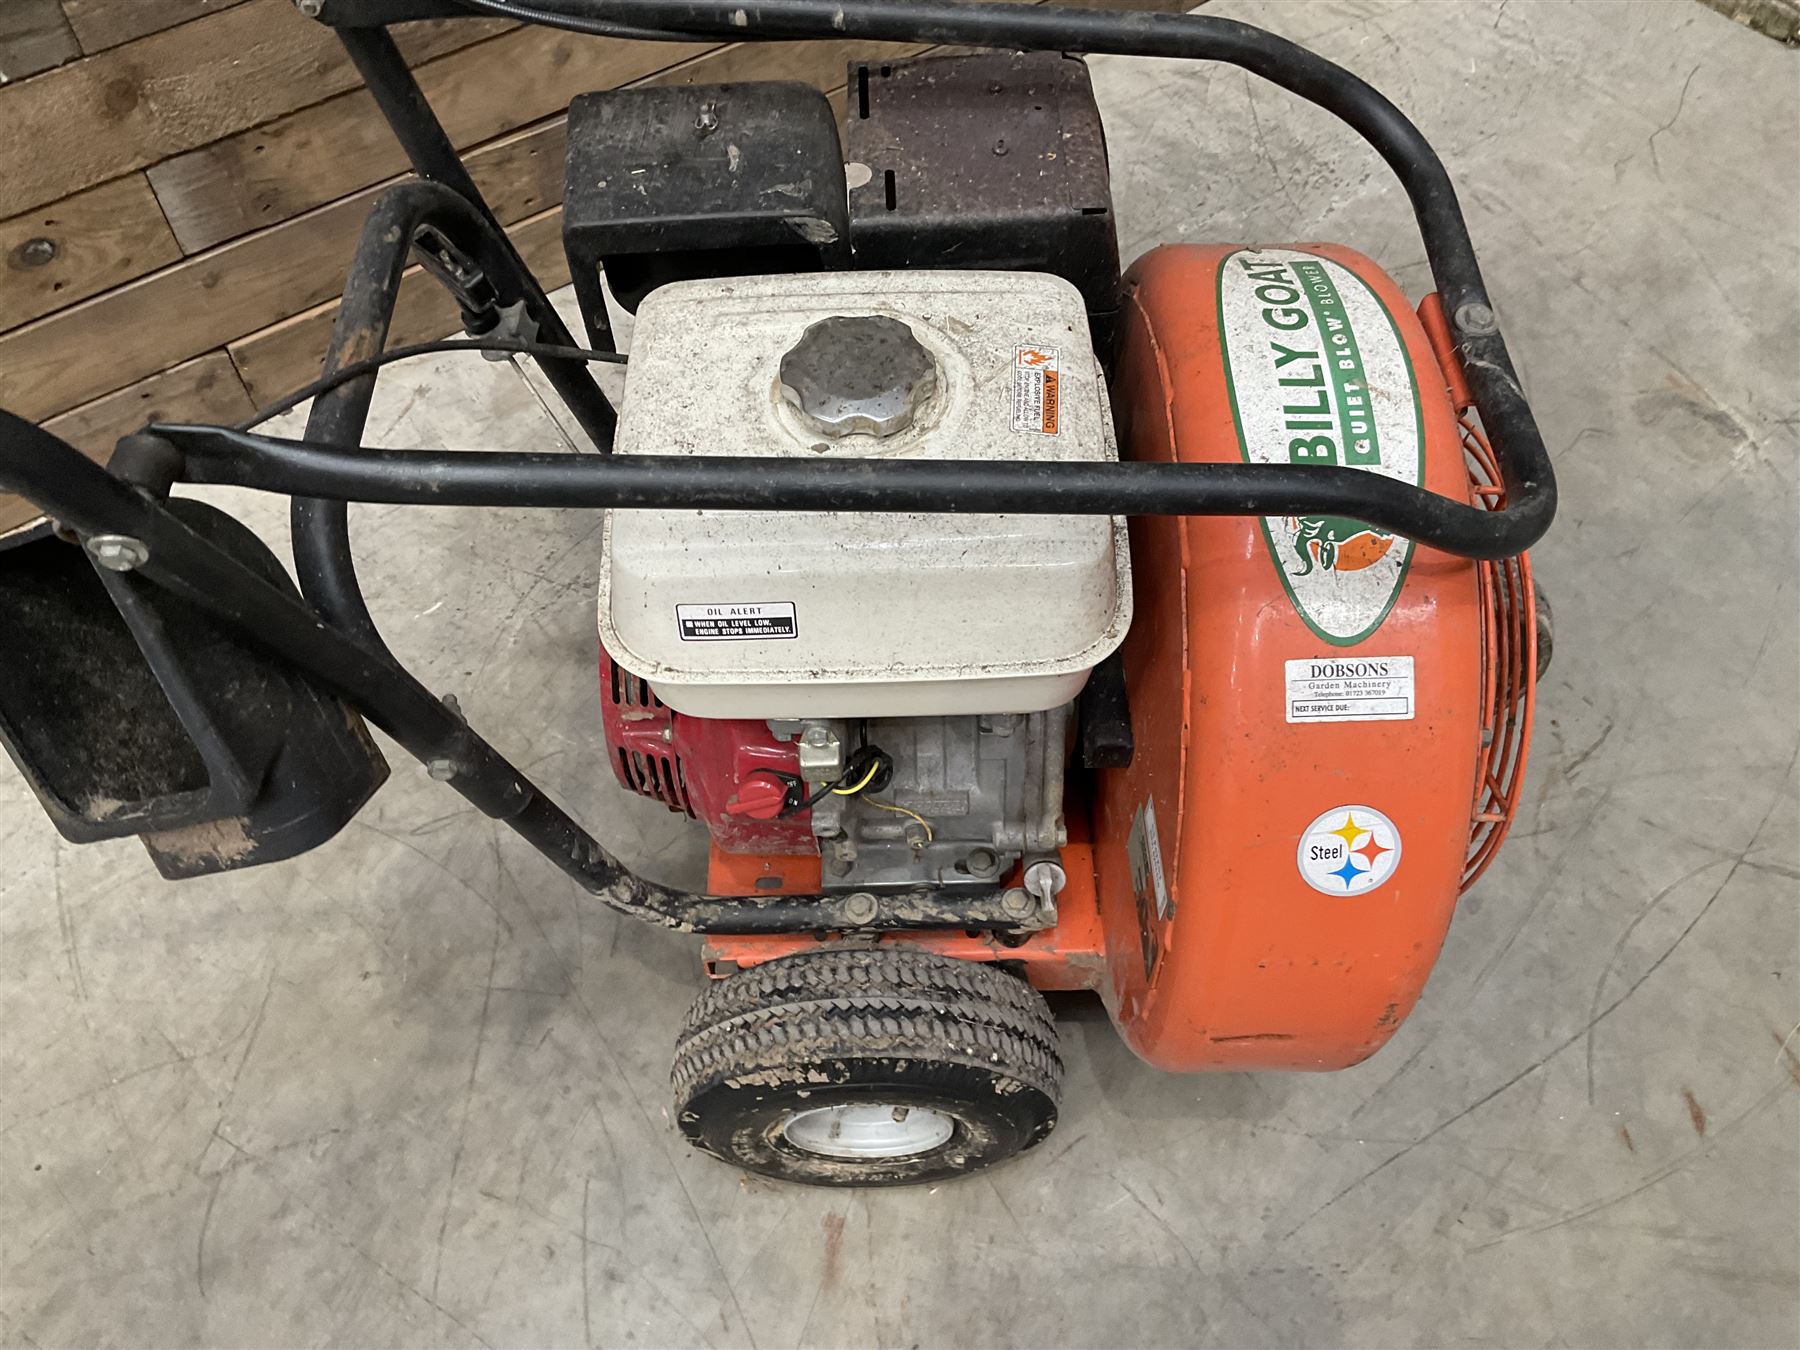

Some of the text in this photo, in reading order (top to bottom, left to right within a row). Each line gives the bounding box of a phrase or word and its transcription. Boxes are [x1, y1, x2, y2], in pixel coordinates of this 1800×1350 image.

[1303, 265, 1334, 305] BLOWER
[1238, 259, 1338, 465] BILLY GOAT
[1045, 385, 1055, 429] WARNING
[1344, 382, 1371, 455] QUIET
[707, 607, 762, 616] OIL ALERT
[694, 620, 715, 628] WHEN
[695, 628, 720, 636] ENGINE
[745, 626, 791, 635] IMMEDIATELY.
[1311, 662, 1389, 679] DOBSONS
[1308, 680, 1392, 690] Garden Machinery
[1295, 705, 1309, 713] NEXT
[1310, 704, 1334, 712] SERVICE
[1310, 844, 1343, 861] Steel
